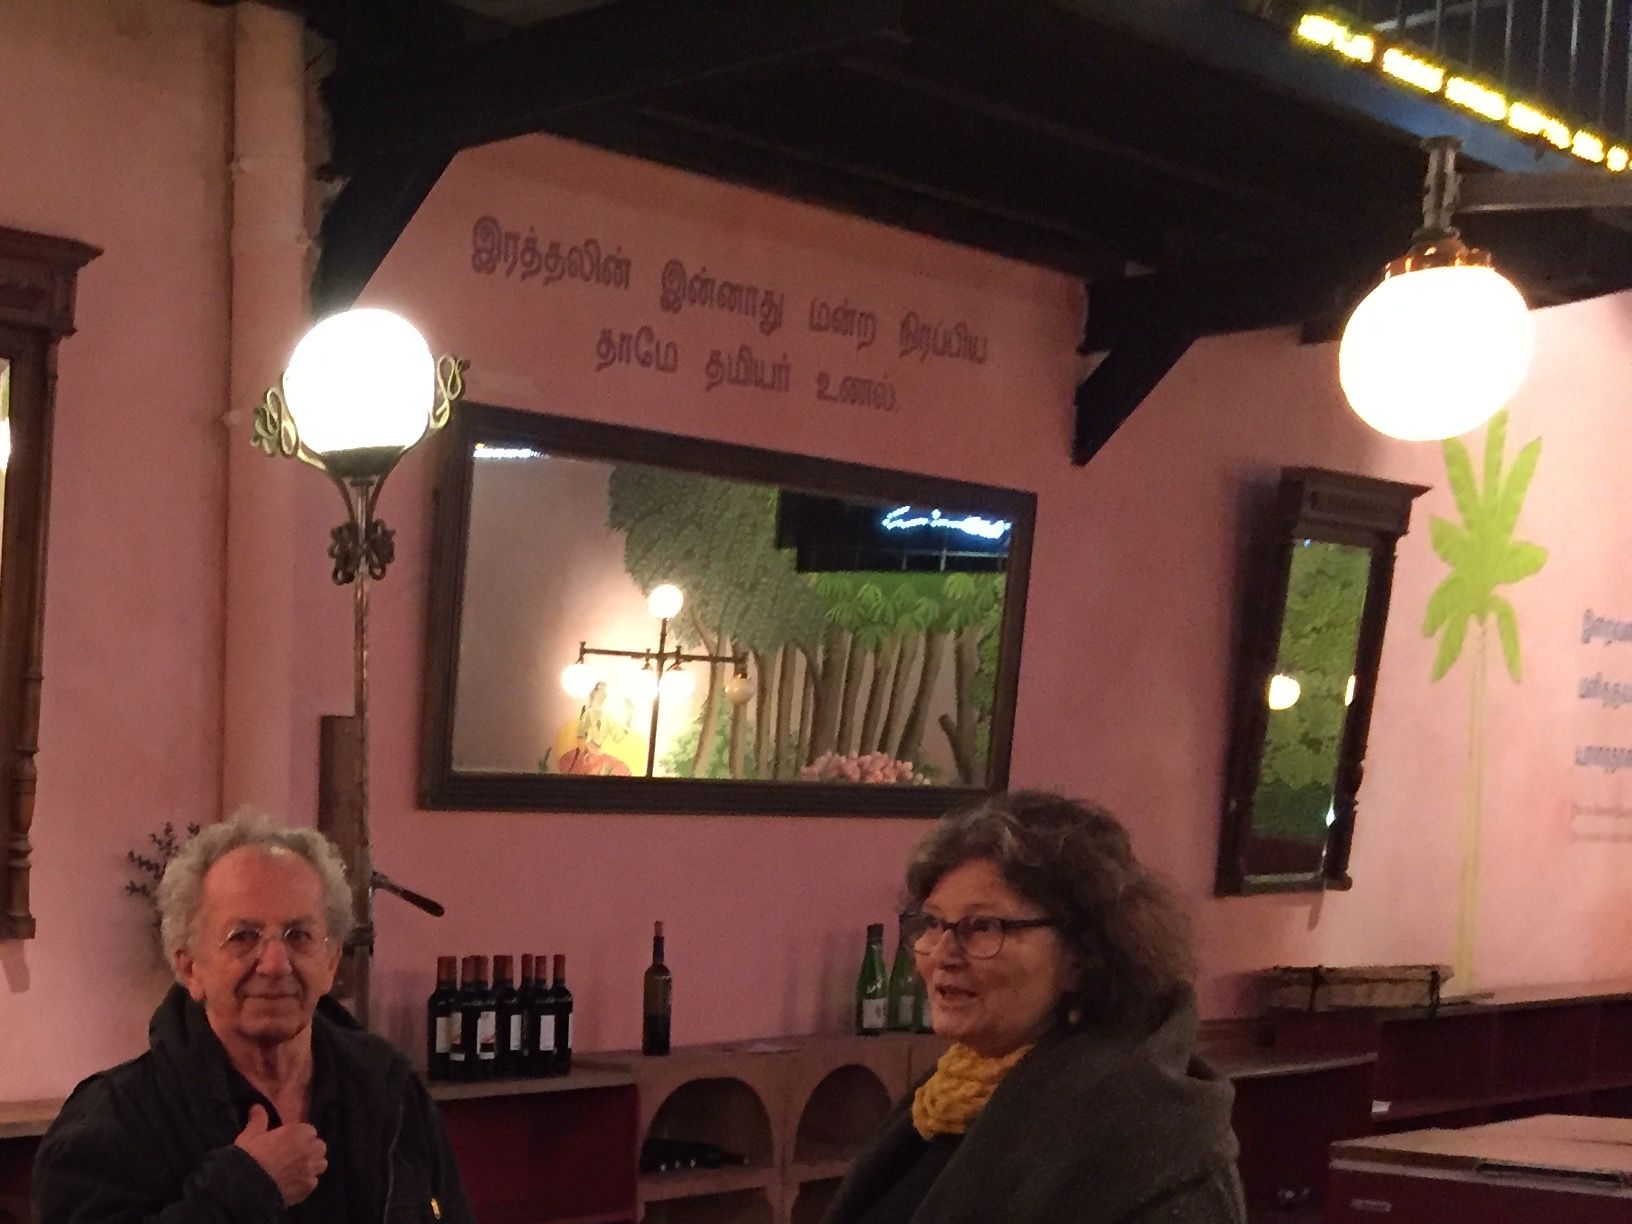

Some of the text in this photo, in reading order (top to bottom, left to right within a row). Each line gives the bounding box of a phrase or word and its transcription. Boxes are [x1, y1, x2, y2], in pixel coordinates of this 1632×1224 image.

[471, 215, 632, 290] இரத்தலின்
[659, 258, 785, 336] இன்னாது
[595, 326, 679, 373] தாமே
